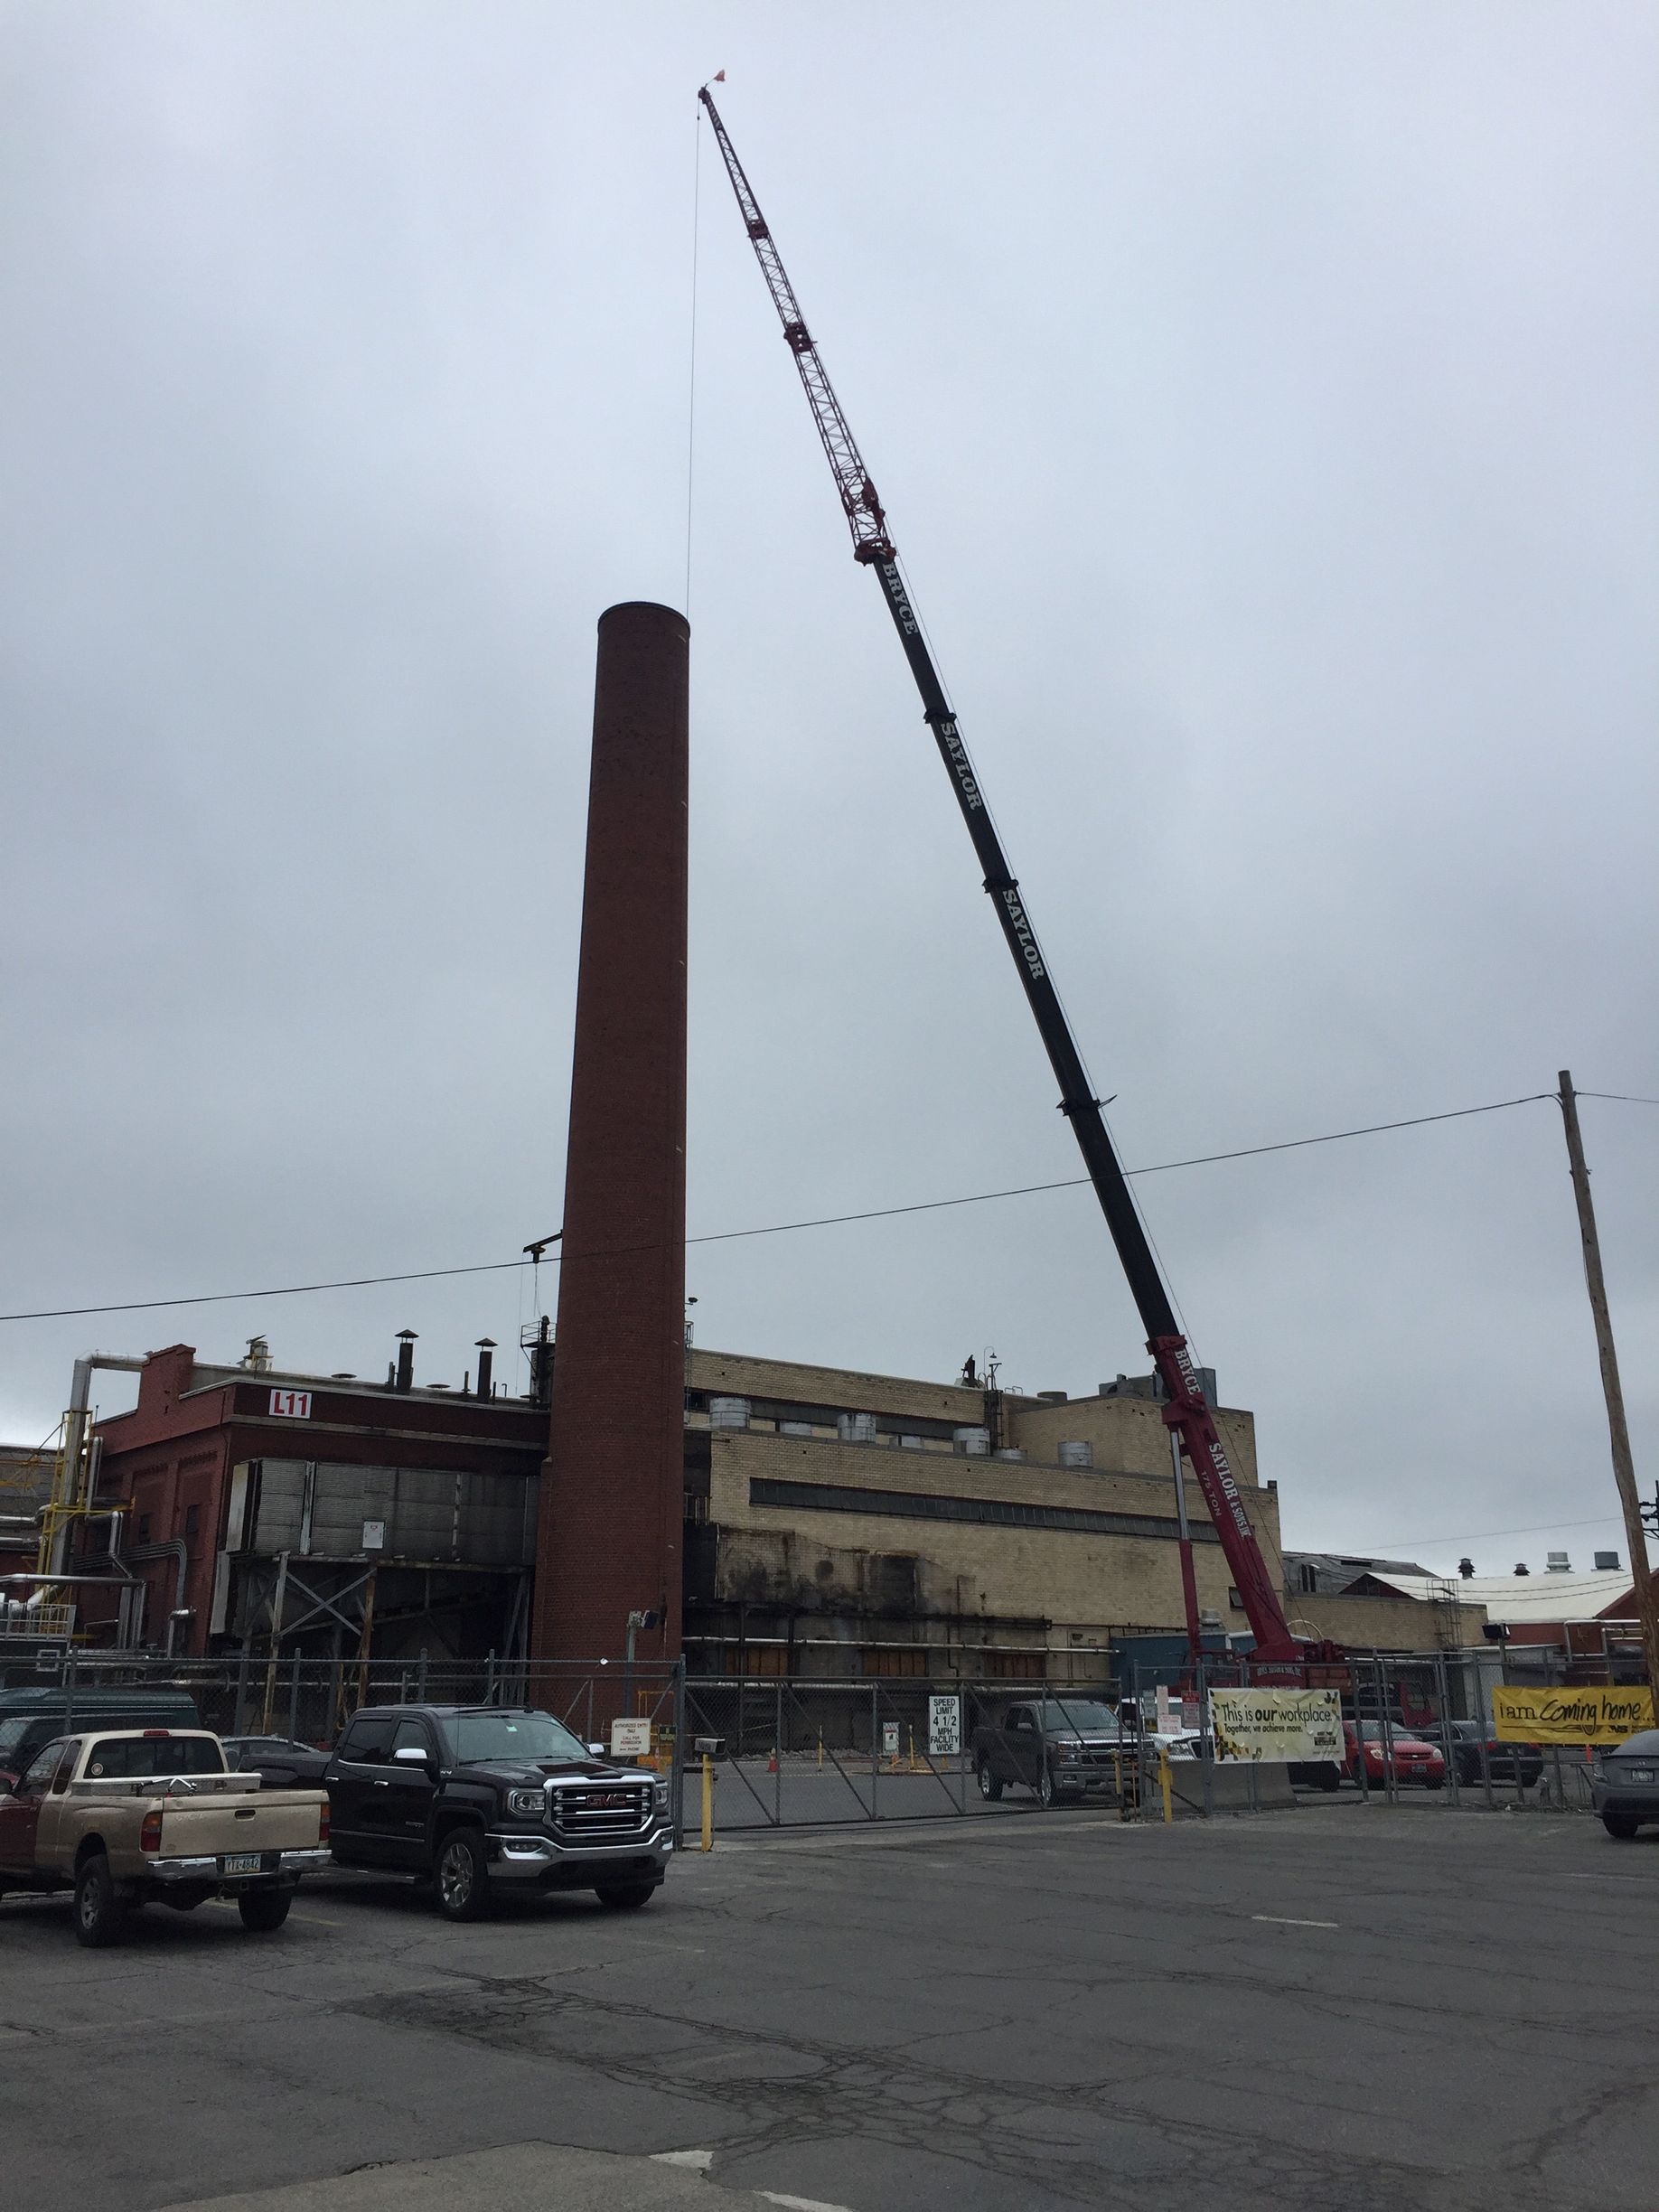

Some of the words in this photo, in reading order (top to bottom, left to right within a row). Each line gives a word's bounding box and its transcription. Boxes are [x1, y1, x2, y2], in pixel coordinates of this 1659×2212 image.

[883, 562, 919, 634] BRYCE
[941, 722, 982, 810] SAYLOR
[1002, 889, 1045, 979] SAYLOR
[1175, 1348, 1201, 1395] BRYCE
[273, 1392, 308, 1416] L11
[1209, 1442, 1238, 1499] SAYLOR
[1201, 1471, 1211, 1490] 175
[1208, 1492, 1223, 1517] TON
[933, 1699, 955, 1707] SPEED
[1221, 1702, 1243, 1722] This
[1244, 1705, 1253, 1721] is
[1254, 1709, 1278, 1722] our
[1279, 1702, 1333, 1727] workplace.
[1506, 1705, 1538, 1720] am
[933, 1716, 939, 1726] 4
[942, 1714, 957, 1727] 1/2
[1224, 1723, 1251, 1735] Together,
[1262, 1722, 1286, 1733] achieve
[1286, 1725, 1303, 1733] more.
[930, 1735, 959, 1743] FACILITY
[936, 1744, 954, 1752] WIDE
[586, 1794, 627, 1807] GMC
